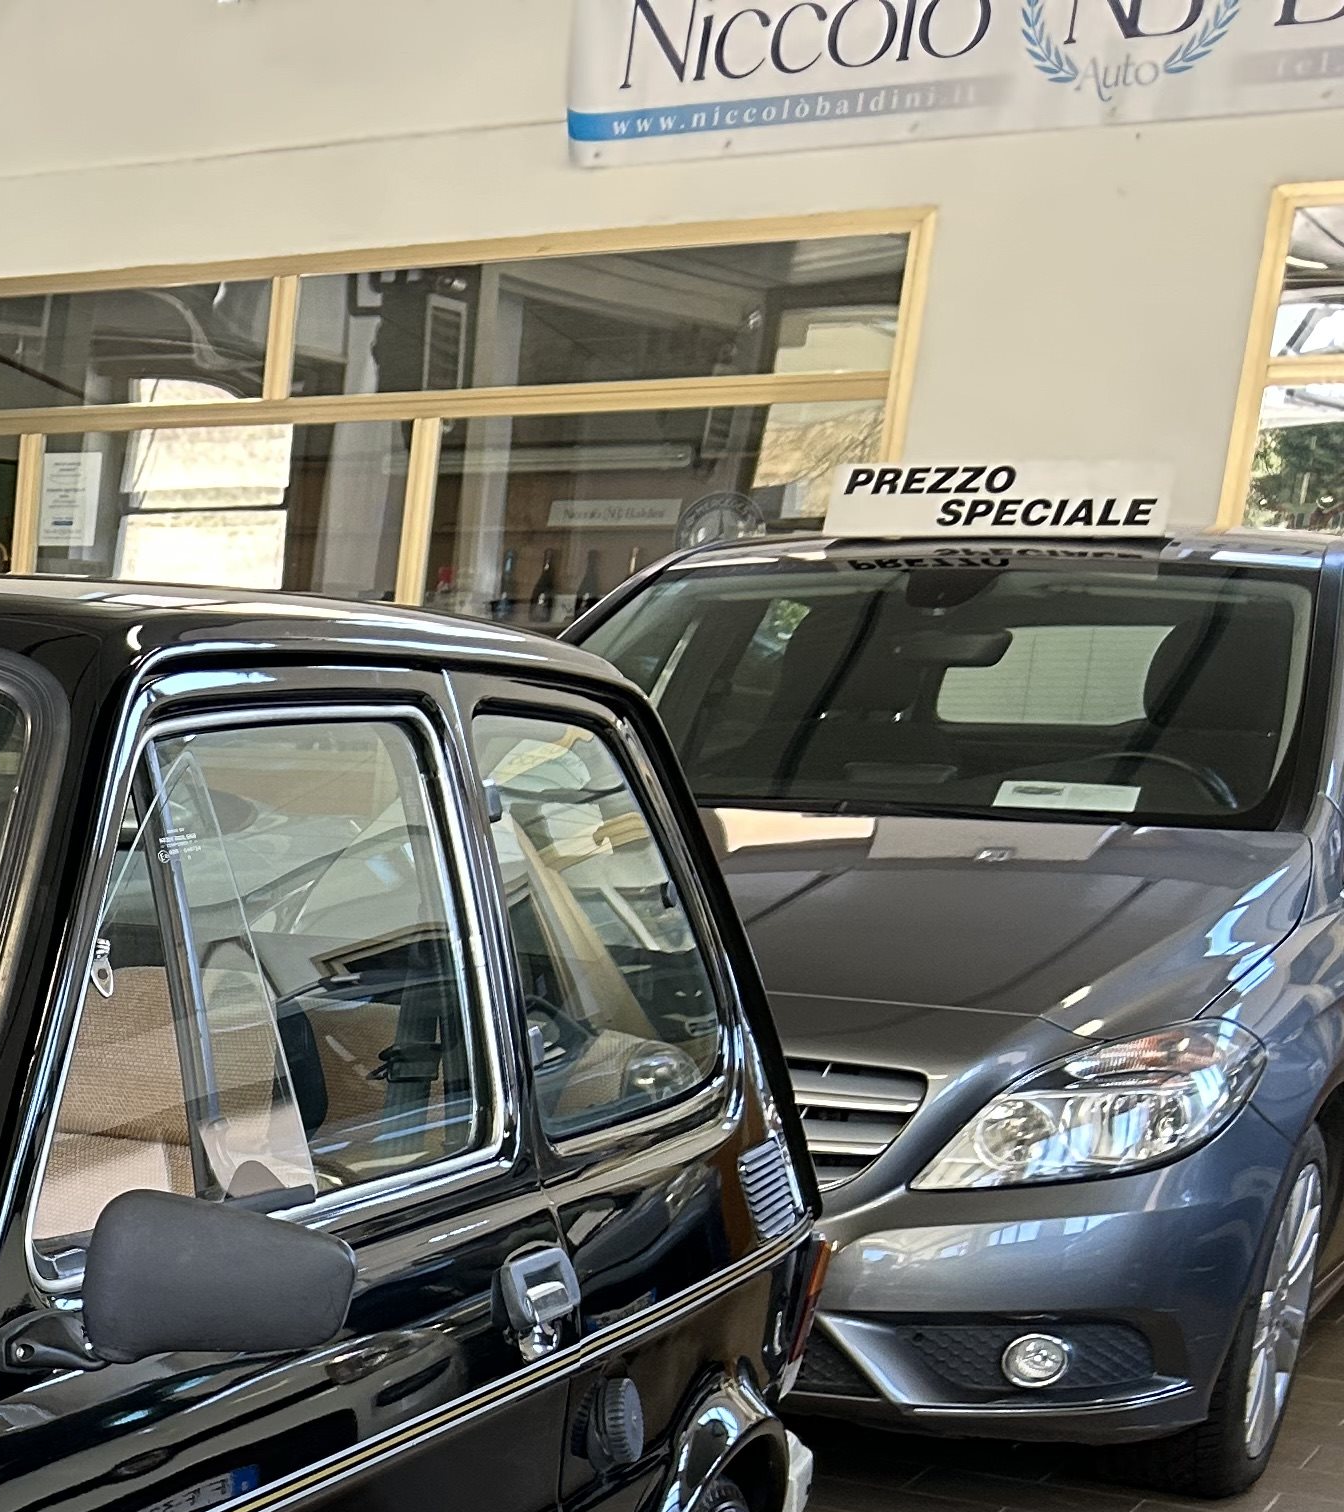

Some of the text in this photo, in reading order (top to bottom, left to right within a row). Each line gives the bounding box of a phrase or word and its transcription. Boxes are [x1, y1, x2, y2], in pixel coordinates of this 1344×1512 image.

[1075, 53, 1160, 101] Auto
[844, 465, 1017, 495] PREZZO
[936, 498, 1158, 526] SPECIALE
